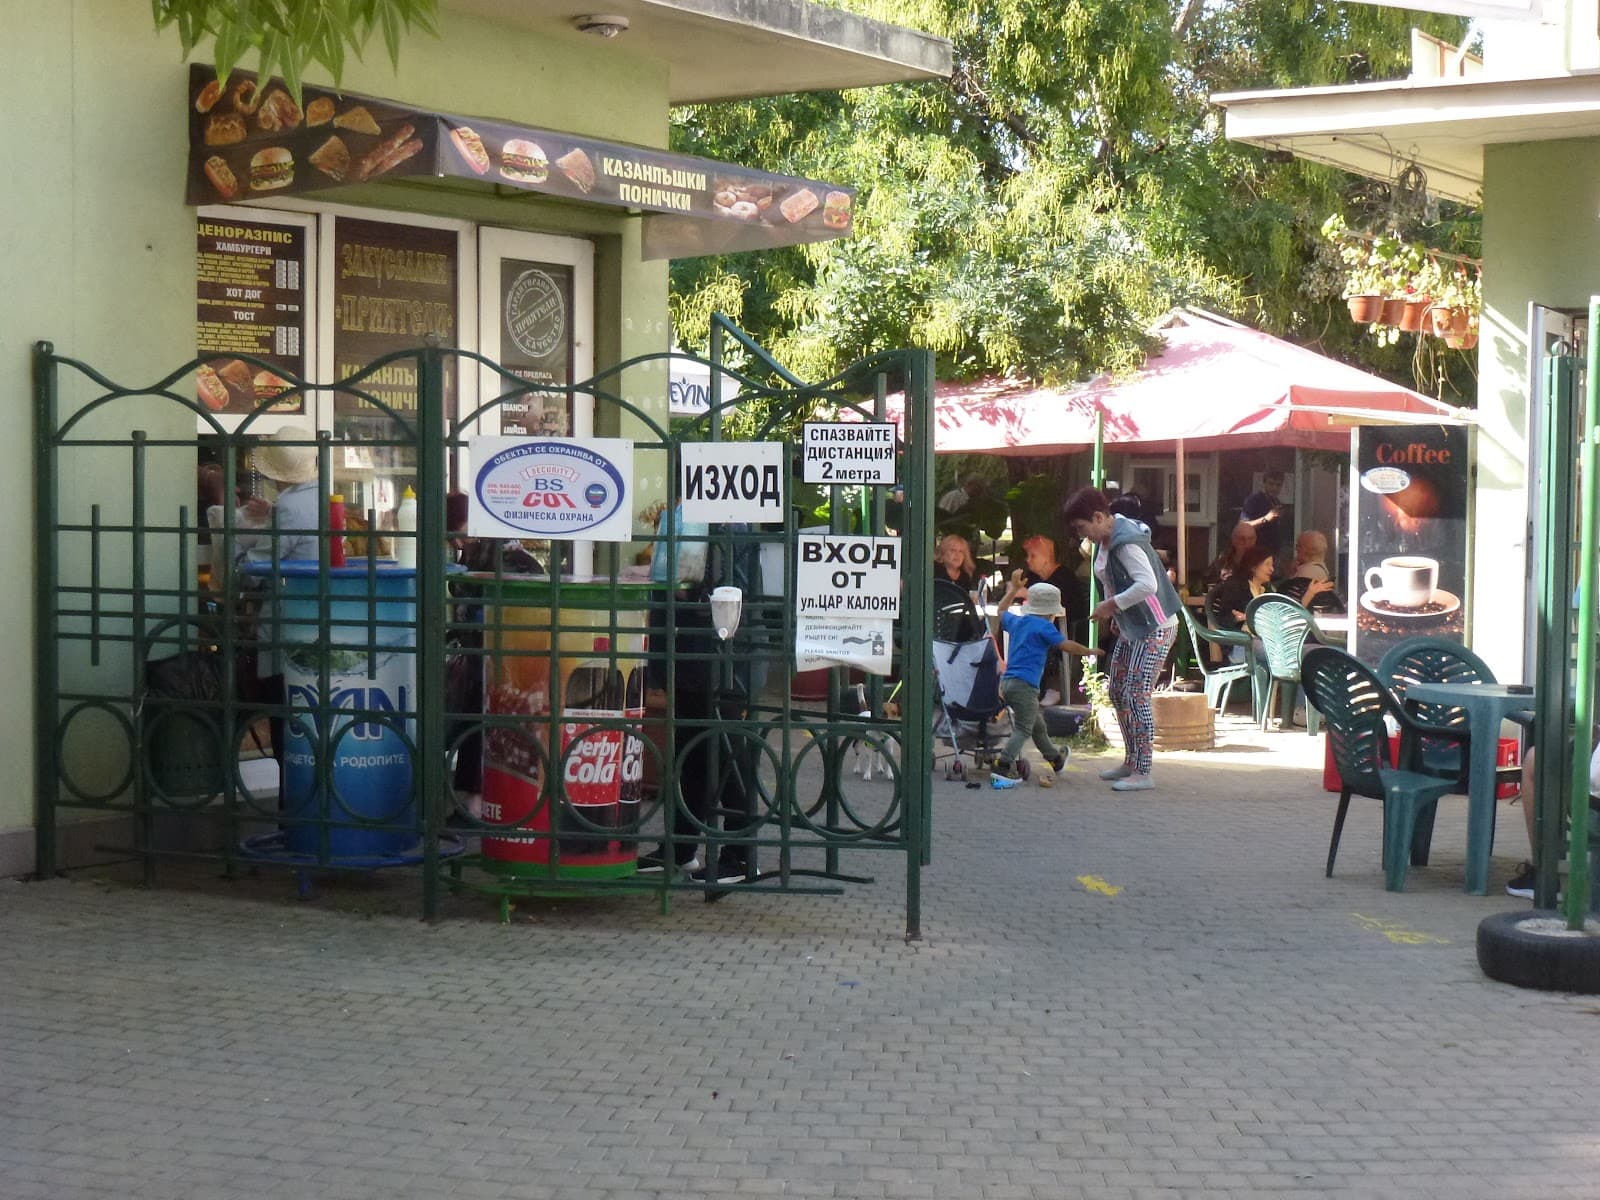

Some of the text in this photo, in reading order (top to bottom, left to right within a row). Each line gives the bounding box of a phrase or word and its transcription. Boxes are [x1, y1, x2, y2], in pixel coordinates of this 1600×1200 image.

[603, 157, 707, 191] КАЗАНЛЪШКИ
[619, 183, 691, 211] ПОНИЧКИ
[216, 241, 272, 256] ХАМБУРГЕРИ
[226, 287, 262, 300] ХОТ ДОГ
[233, 310, 255, 321] ТОСТ
[810, 428, 890, 442] СПАЗВАЙТЕ
[494, 446, 607, 468] ОБЕКТЪТ СЕ ОХРАНЯВА ОТ
[807, 446, 893, 462] ДИСТАНЦИЯ
[1376, 443, 1452, 465] Coffee
[531, 466, 569, 475] SECURITY
[822, 462, 881, 482] 2 метра
[535, 478, 564, 491] BS
[685, 465, 781, 507] ИЗХОД
[504, 510, 594, 522] ФИЗИЧЕСКА ОХРАНА
[803, 542, 896, 569] ВХОД
[832, 571, 867, 589] ОТ
[801, 594, 897, 611] ул.ЦАР КАЛОЯН
[341, 754, 405, 769] РОДОПИТЕ
[564, 755, 617, 784] Cola
